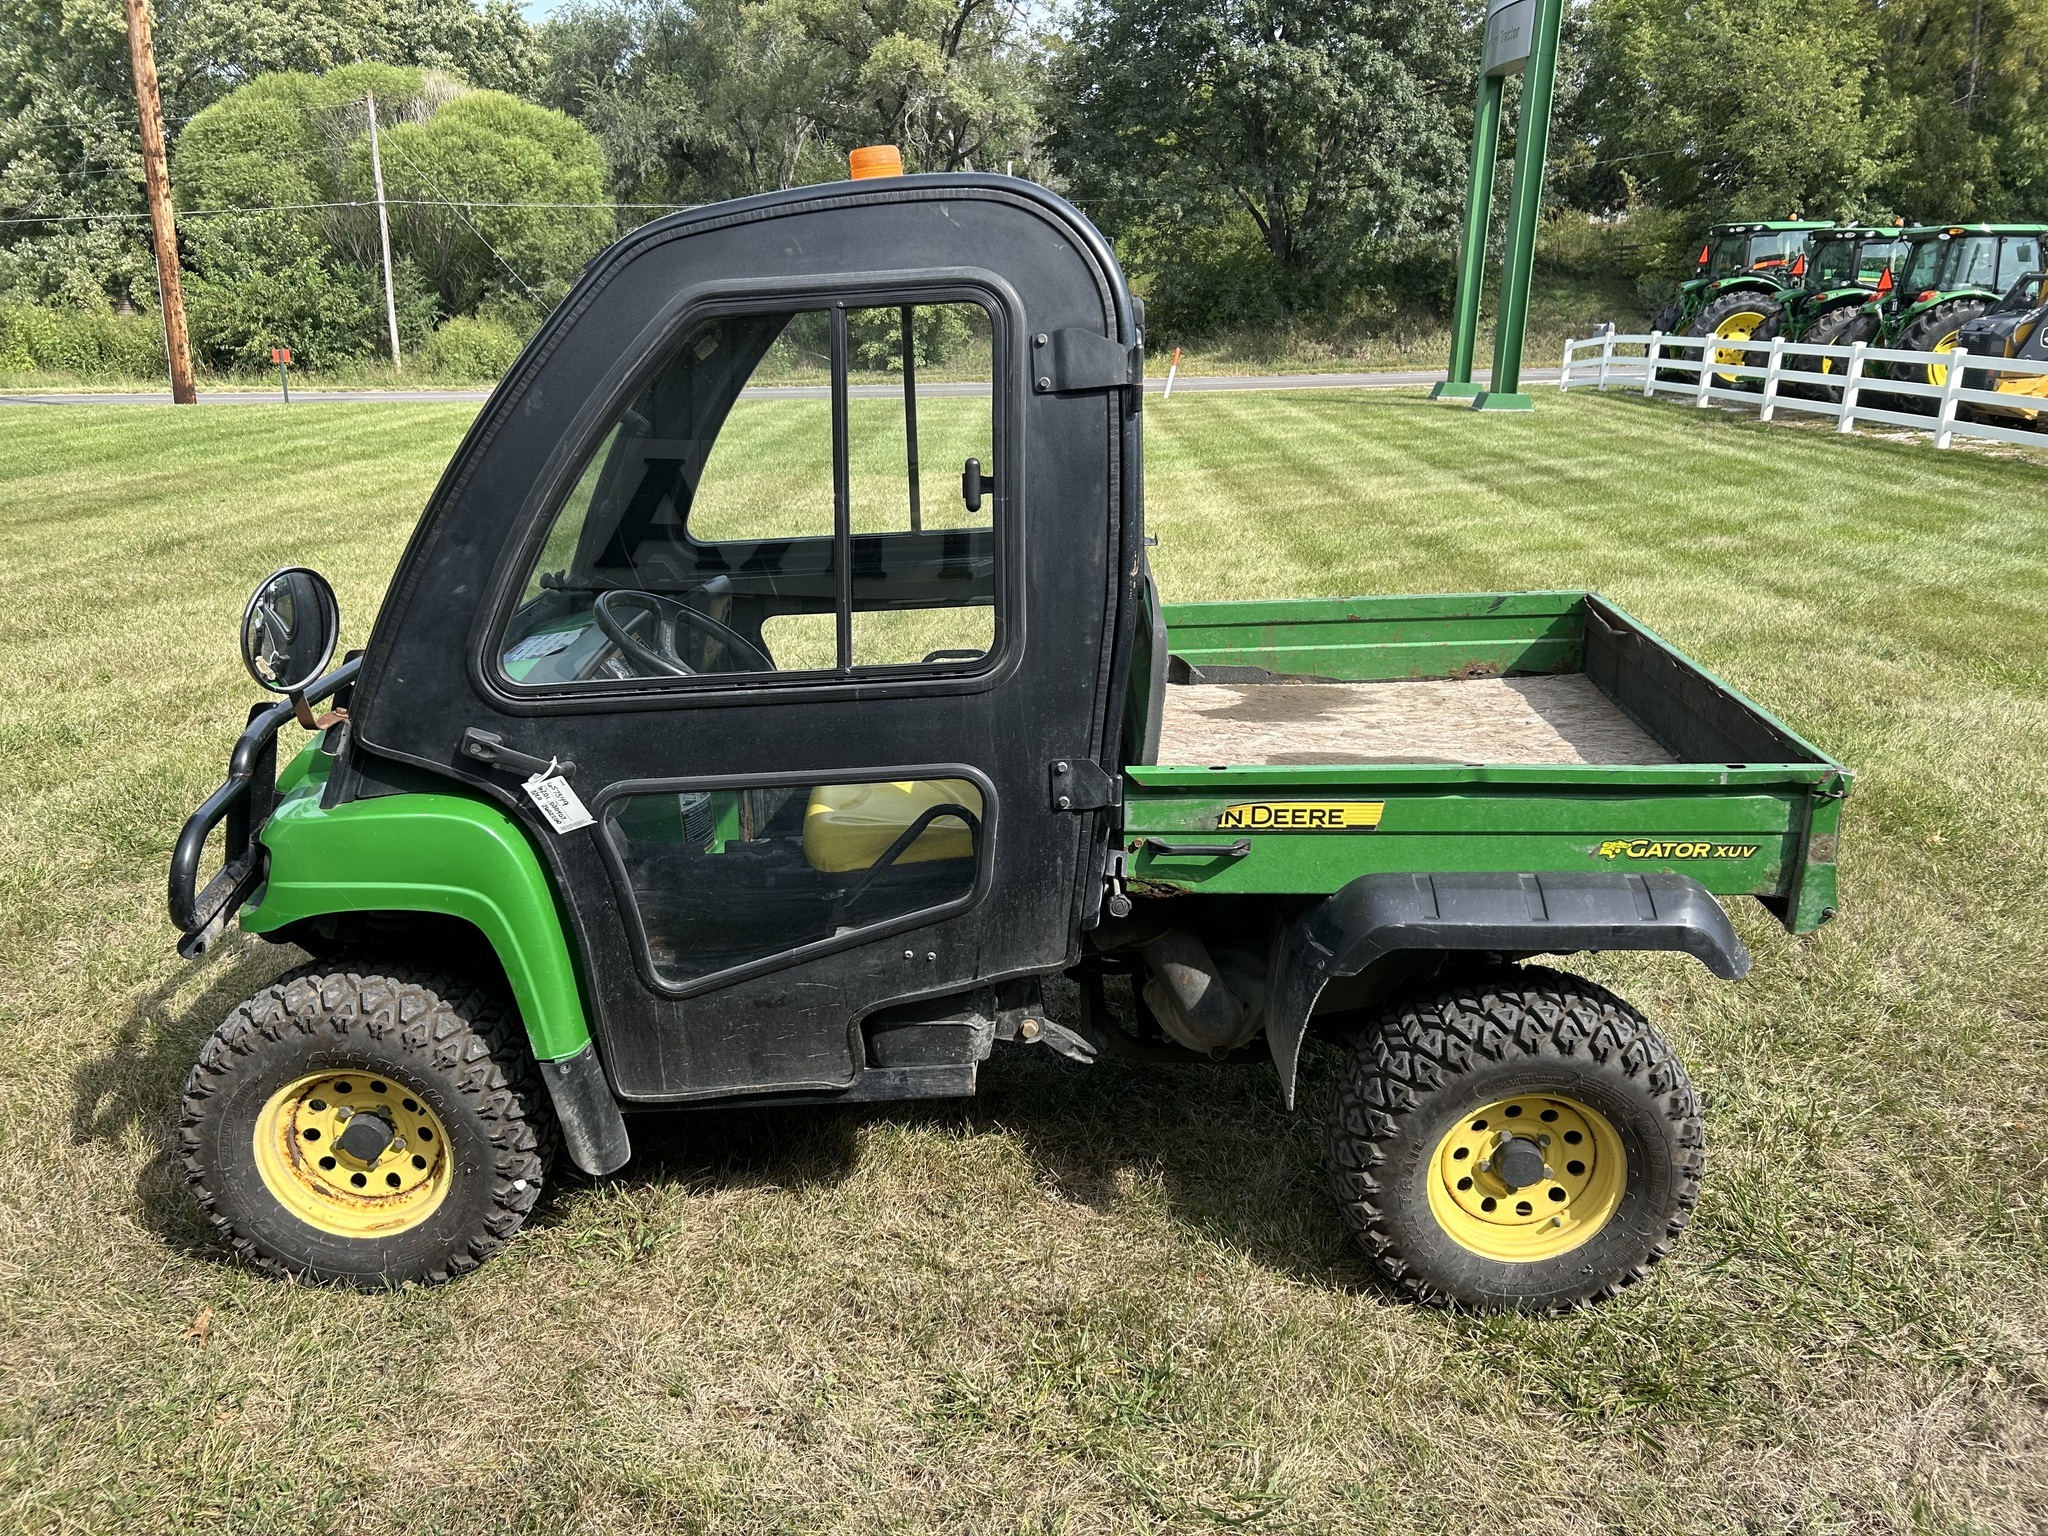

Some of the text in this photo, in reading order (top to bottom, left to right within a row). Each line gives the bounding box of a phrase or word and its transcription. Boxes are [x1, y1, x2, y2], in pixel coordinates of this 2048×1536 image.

[1251, 806, 1345, 825] DEERE
[1627, 840, 1758, 858] GATOR XUV
